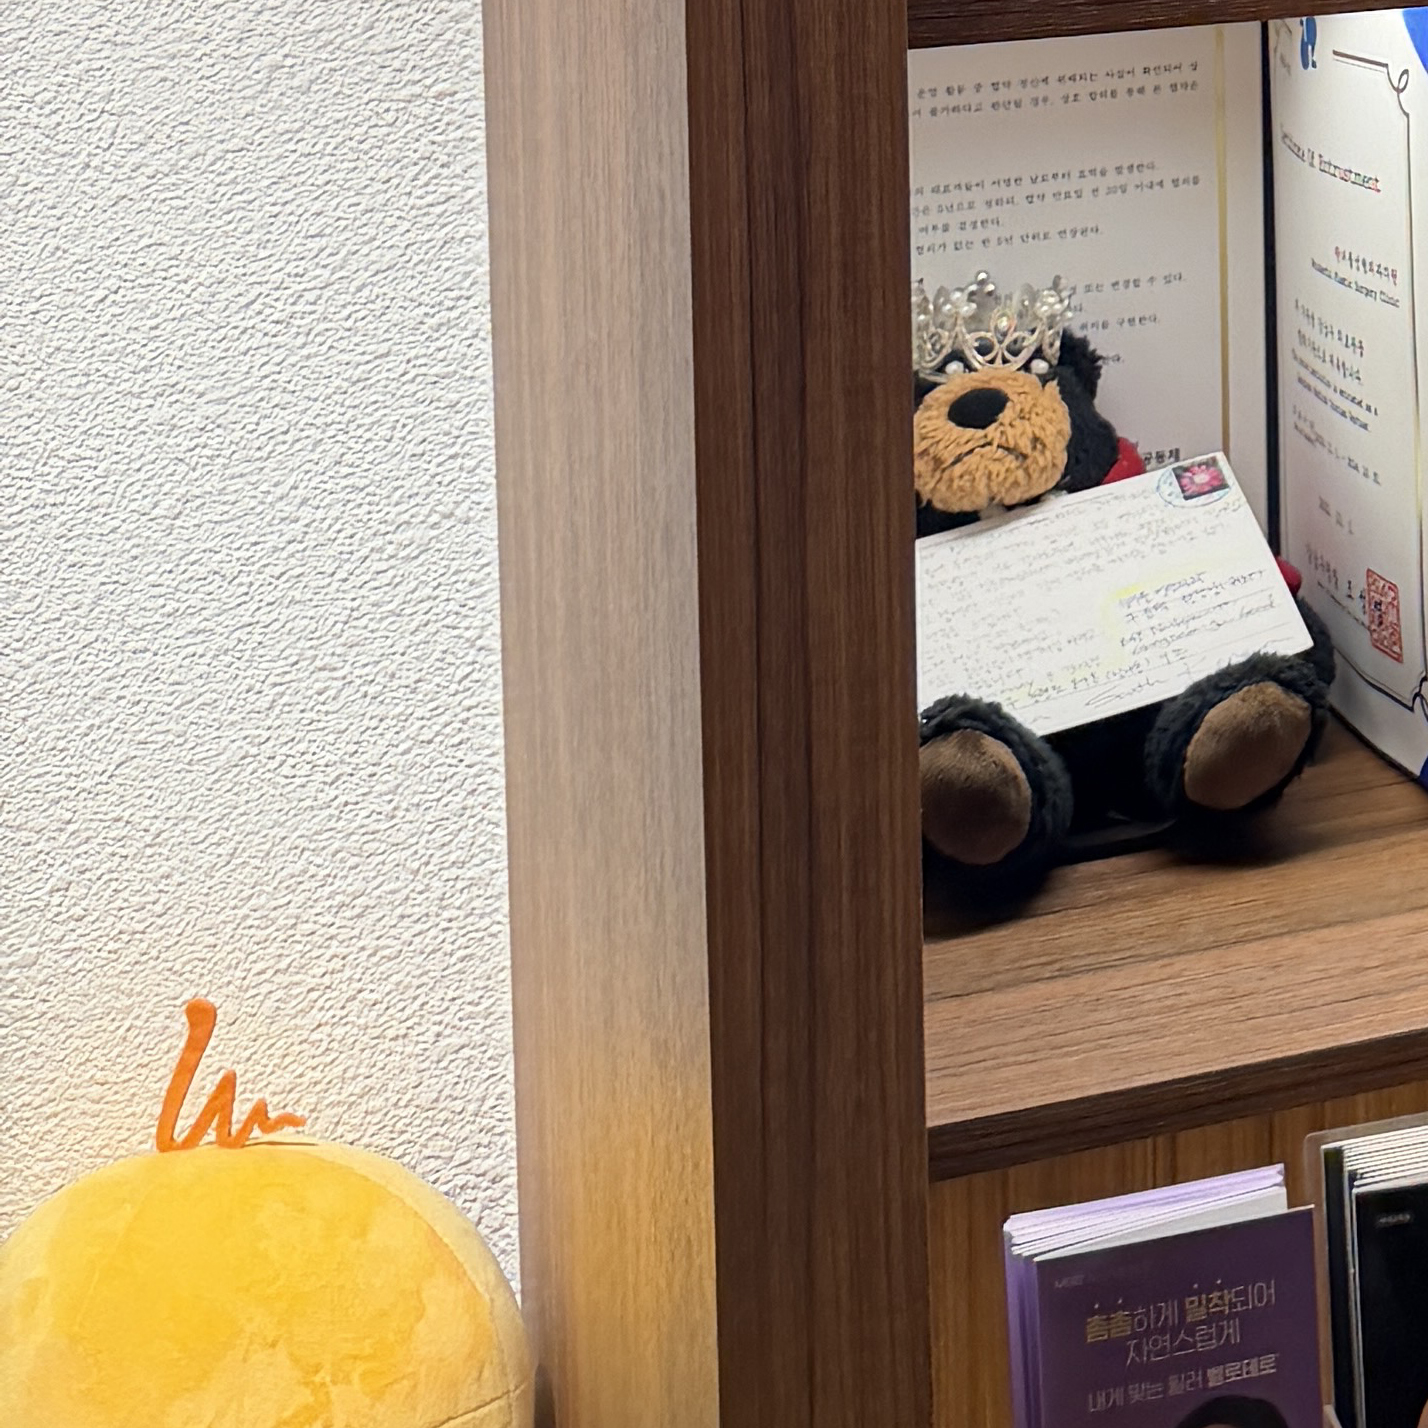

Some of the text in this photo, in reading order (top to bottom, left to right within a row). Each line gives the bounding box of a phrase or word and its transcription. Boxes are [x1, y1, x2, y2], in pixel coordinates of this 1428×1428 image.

[1084, 1280, 1275, 1344] 촘촘하게 밀착되어
[1125, 1317, 1241, 1368] 자연스럽게
[1087, 1387, 1125, 1413] 내게
[1128, 1381, 1165, 1404] 맞는
